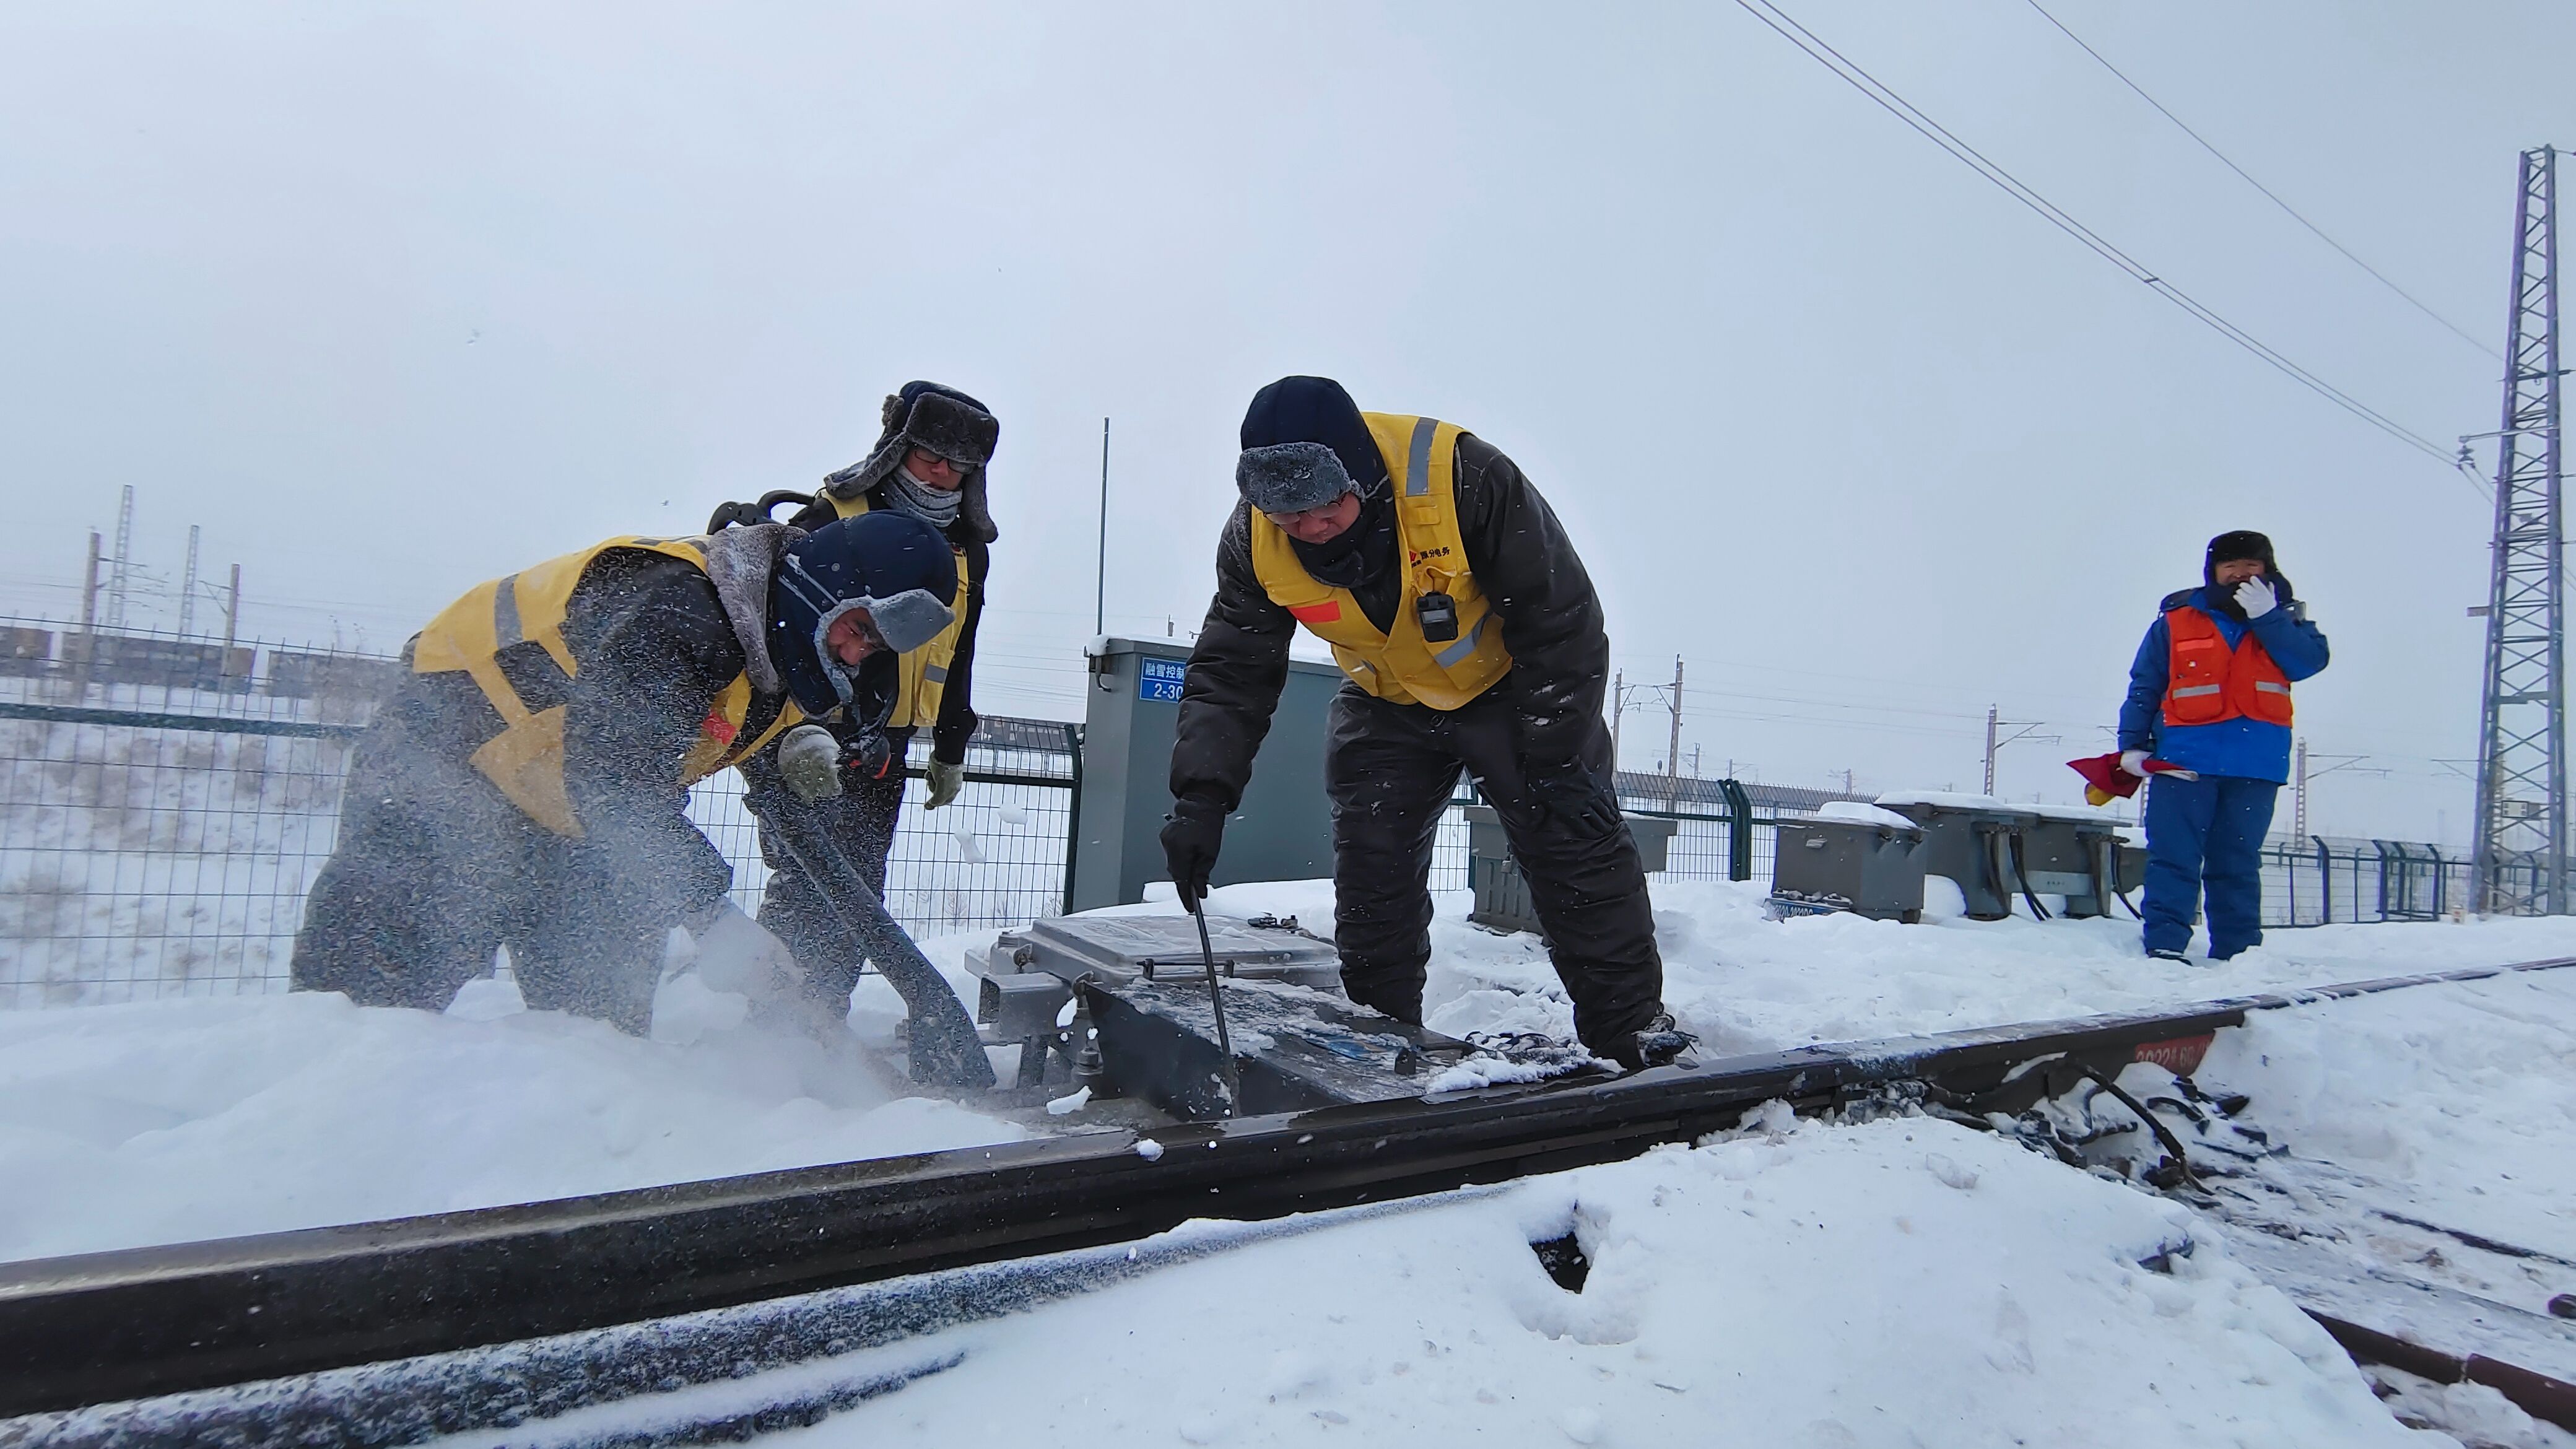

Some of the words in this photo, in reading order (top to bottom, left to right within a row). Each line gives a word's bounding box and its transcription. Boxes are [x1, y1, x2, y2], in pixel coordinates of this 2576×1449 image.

[1146, 662, 1185, 680] 融雪控制
[1154, 683, 1183, 700] 2-30
